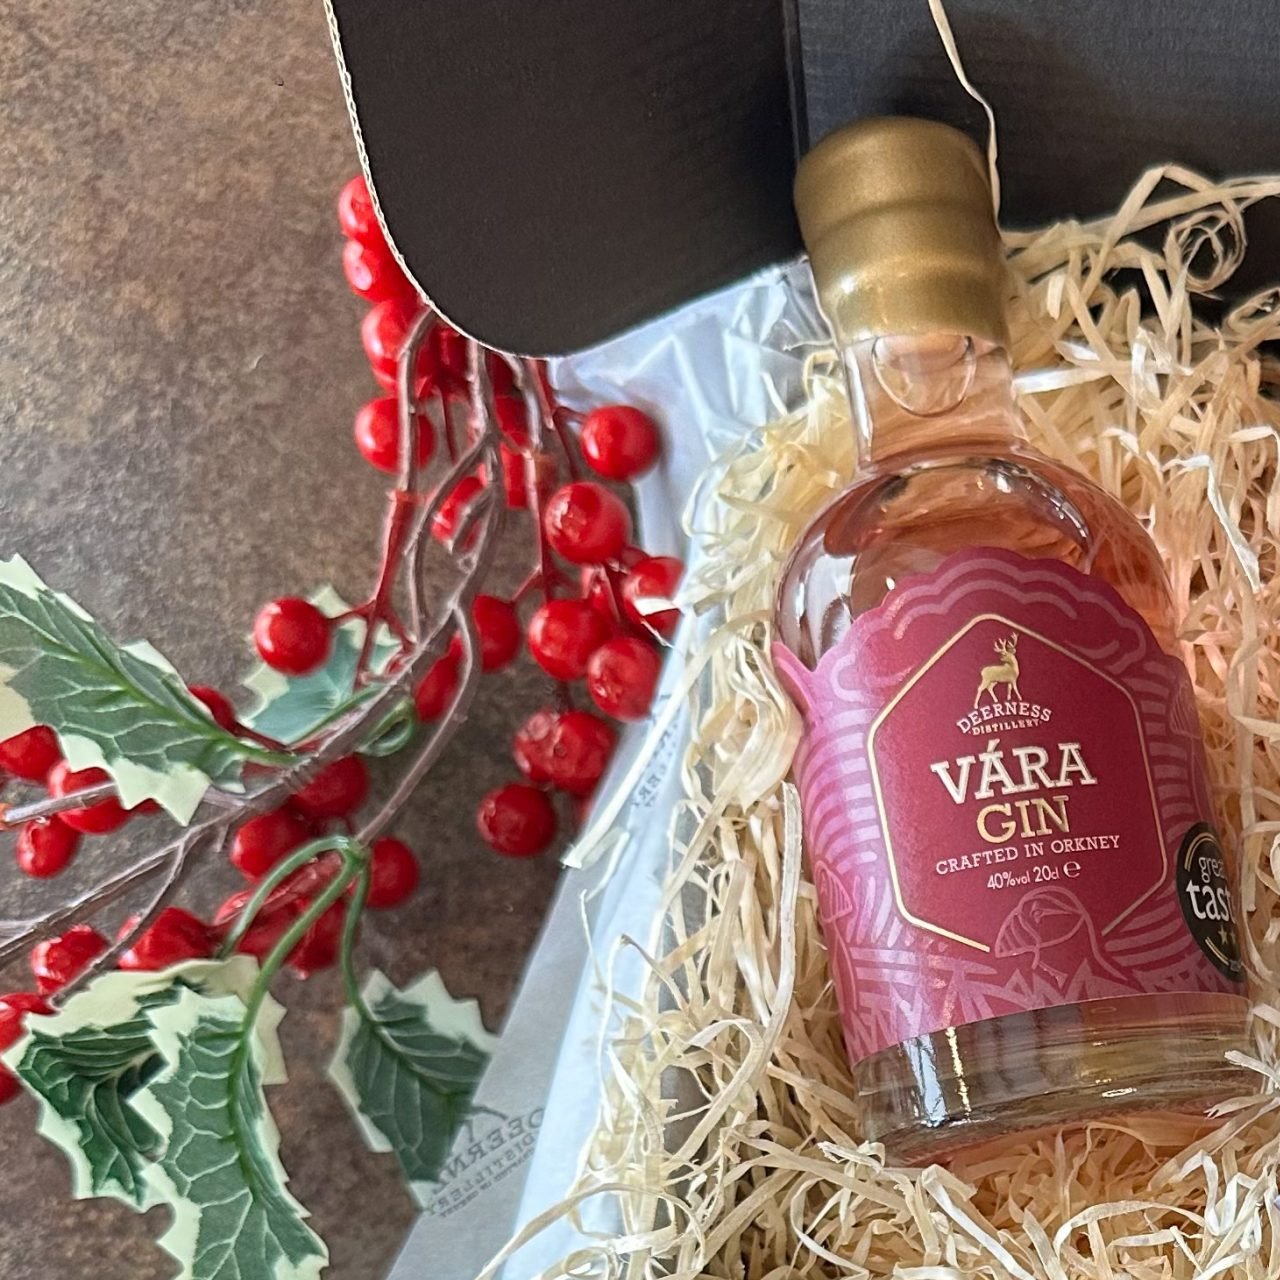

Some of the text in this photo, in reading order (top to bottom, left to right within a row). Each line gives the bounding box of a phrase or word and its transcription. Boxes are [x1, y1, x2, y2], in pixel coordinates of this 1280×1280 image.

[957, 701, 1052, 733] DEERNESS
[930, 738, 1097, 804] VÁRA
[976, 795, 1070, 843] GIN
[936, 835, 1120, 875] CRAFTED IN ORKNEY
[1033, 865, 1059, 882] 20cl
